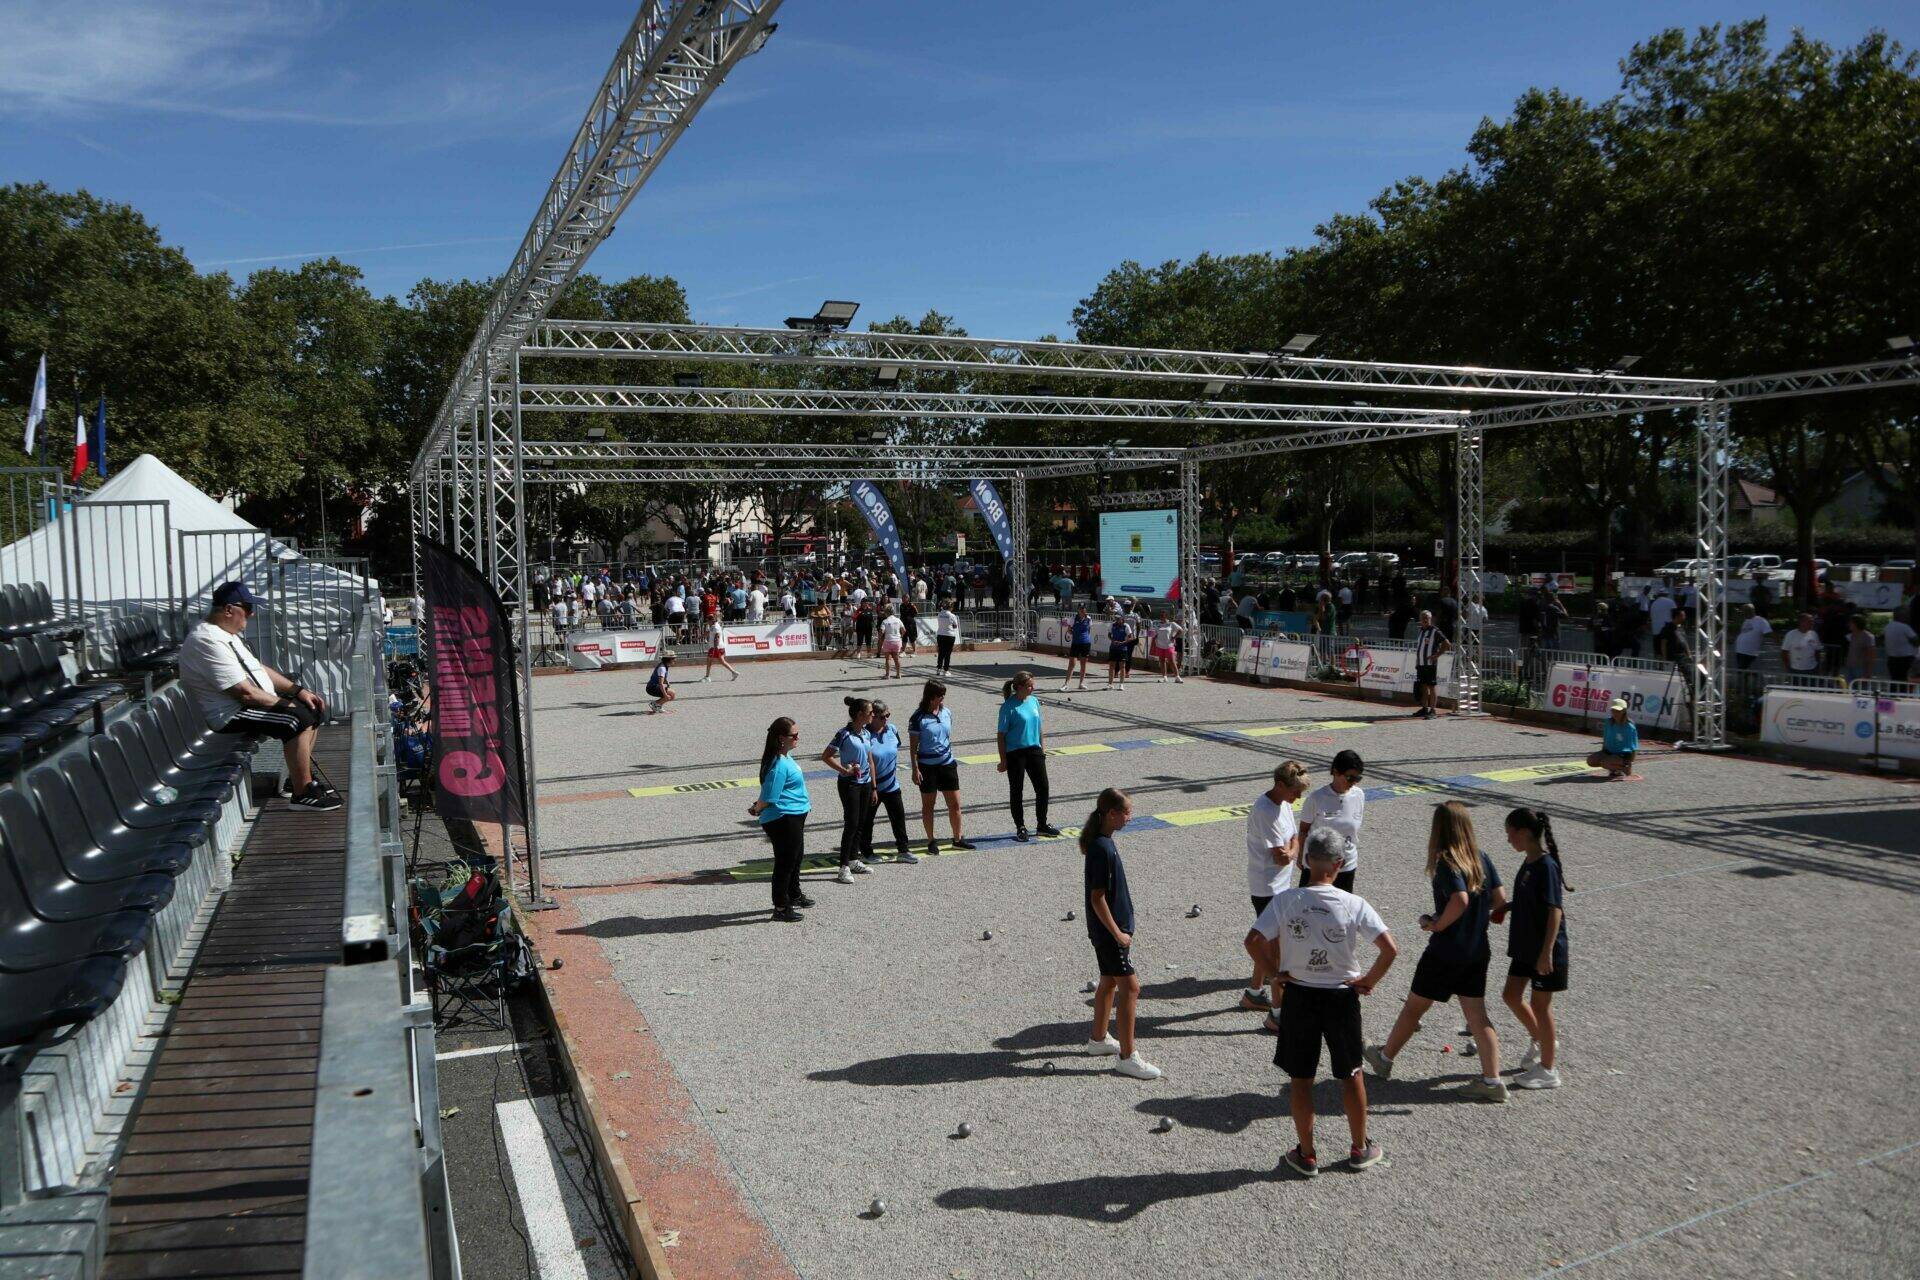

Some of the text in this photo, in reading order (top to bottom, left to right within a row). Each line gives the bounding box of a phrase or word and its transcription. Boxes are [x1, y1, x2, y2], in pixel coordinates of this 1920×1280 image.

[1129, 556, 1144, 564] OBUT
[673, 780, 739, 793] OBUT
[1310, 949, 1328, 960] 50
